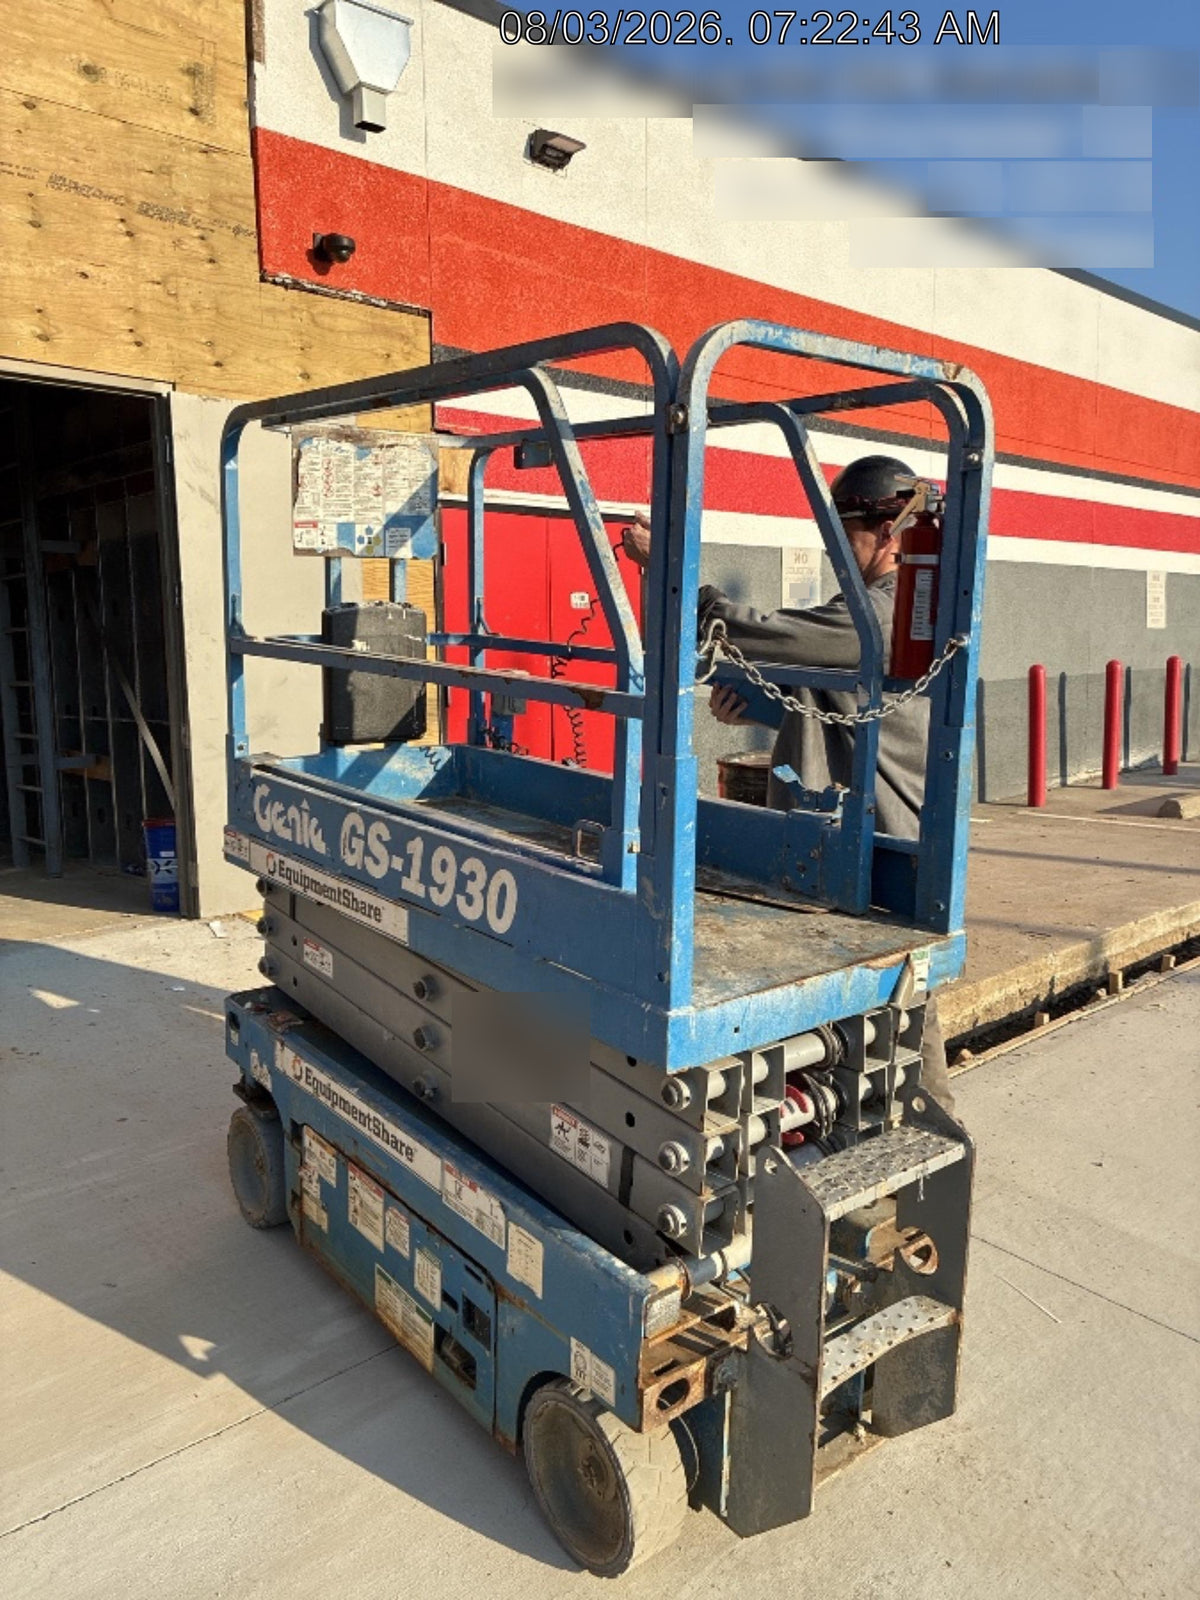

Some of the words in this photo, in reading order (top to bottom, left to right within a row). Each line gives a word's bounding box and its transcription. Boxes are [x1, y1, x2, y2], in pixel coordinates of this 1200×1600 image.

[278, 859, 383, 923] EquipmentShare
[340, 811, 518, 934] GS-1930
[305, 1066, 414, 1163] EquipmentShare
